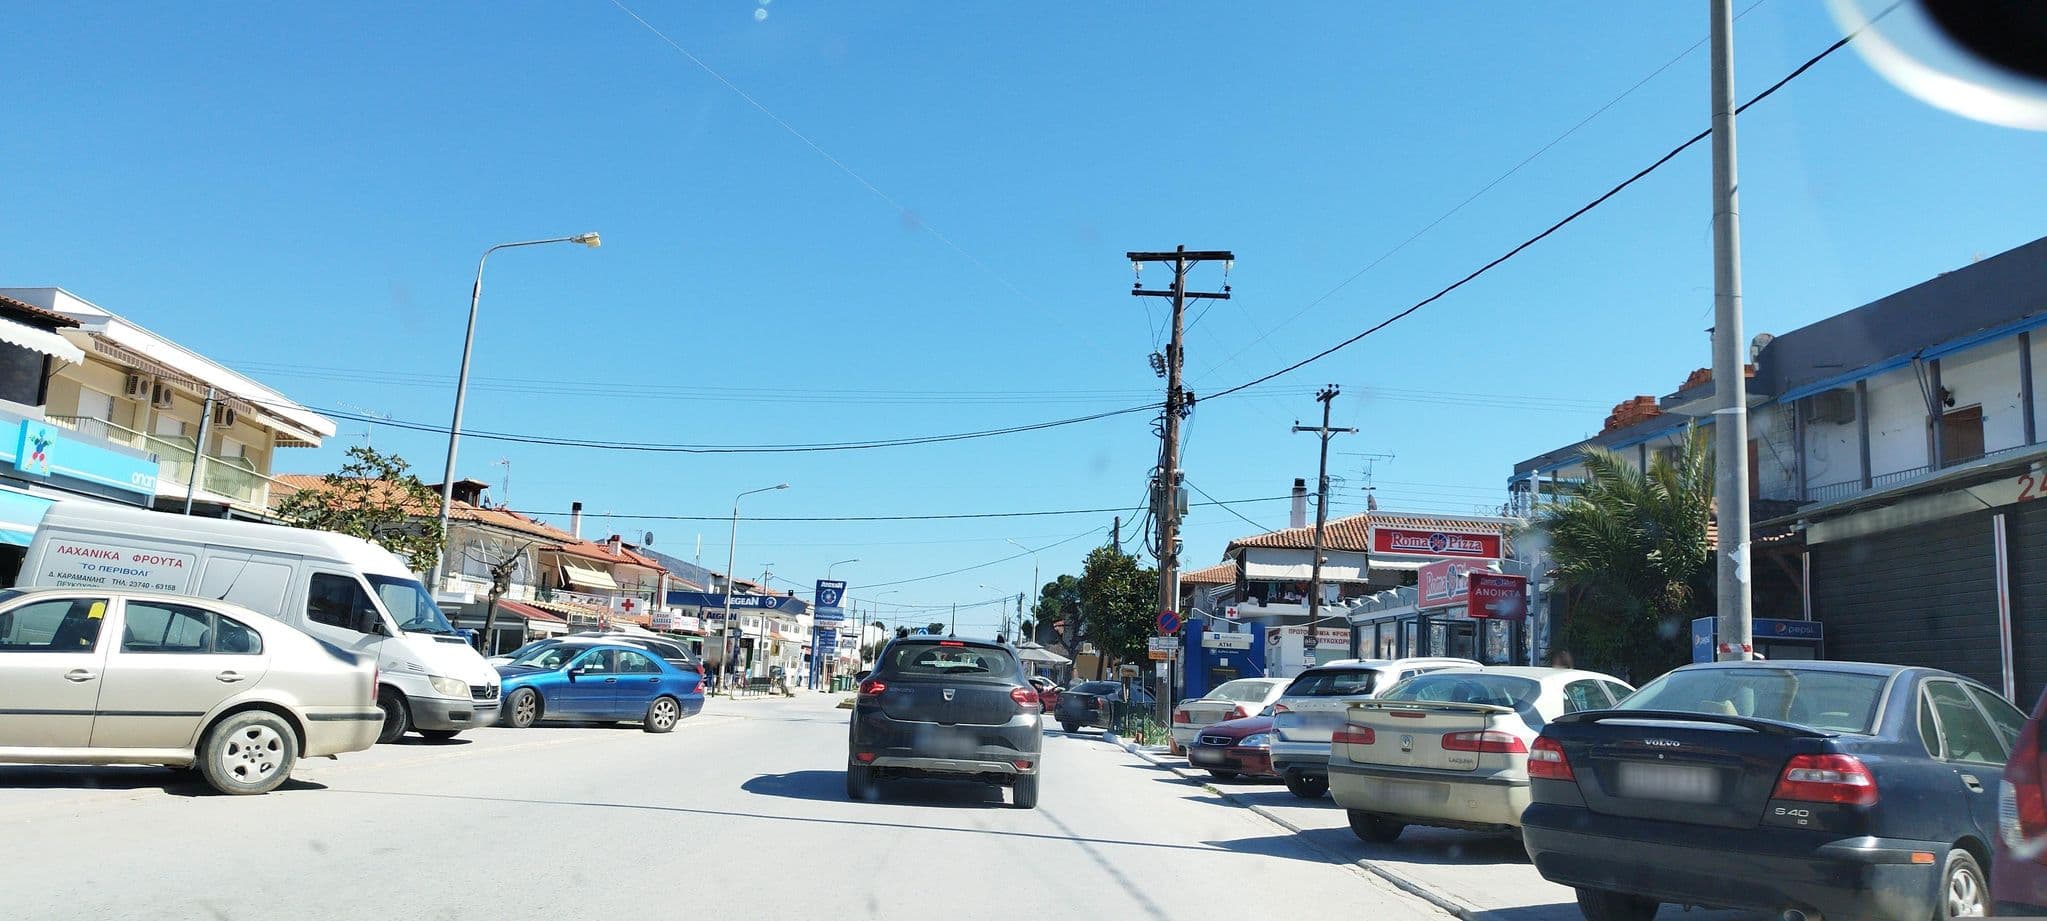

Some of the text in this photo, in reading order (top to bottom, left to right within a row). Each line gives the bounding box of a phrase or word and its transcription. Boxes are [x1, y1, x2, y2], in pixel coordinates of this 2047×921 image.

[1391, 532, 1483, 551] Roma Pizza
[57, 545, 183, 568] ΛΑΧΑΝΙΚΑ ΦΡΟΥΤΑ
[57, 572, 106, 584] ΚΑΡΑΜΑΝΛΗΣ
[129, 581, 150, 589] 23740
[1426, 571, 1447, 596] Roma
[1475, 587, 1521, 598] ΑΝΟΙΚΤΑ
[1788, 626, 1813, 634] pepsi
[1644, 739, 1680, 747] VOLVO
